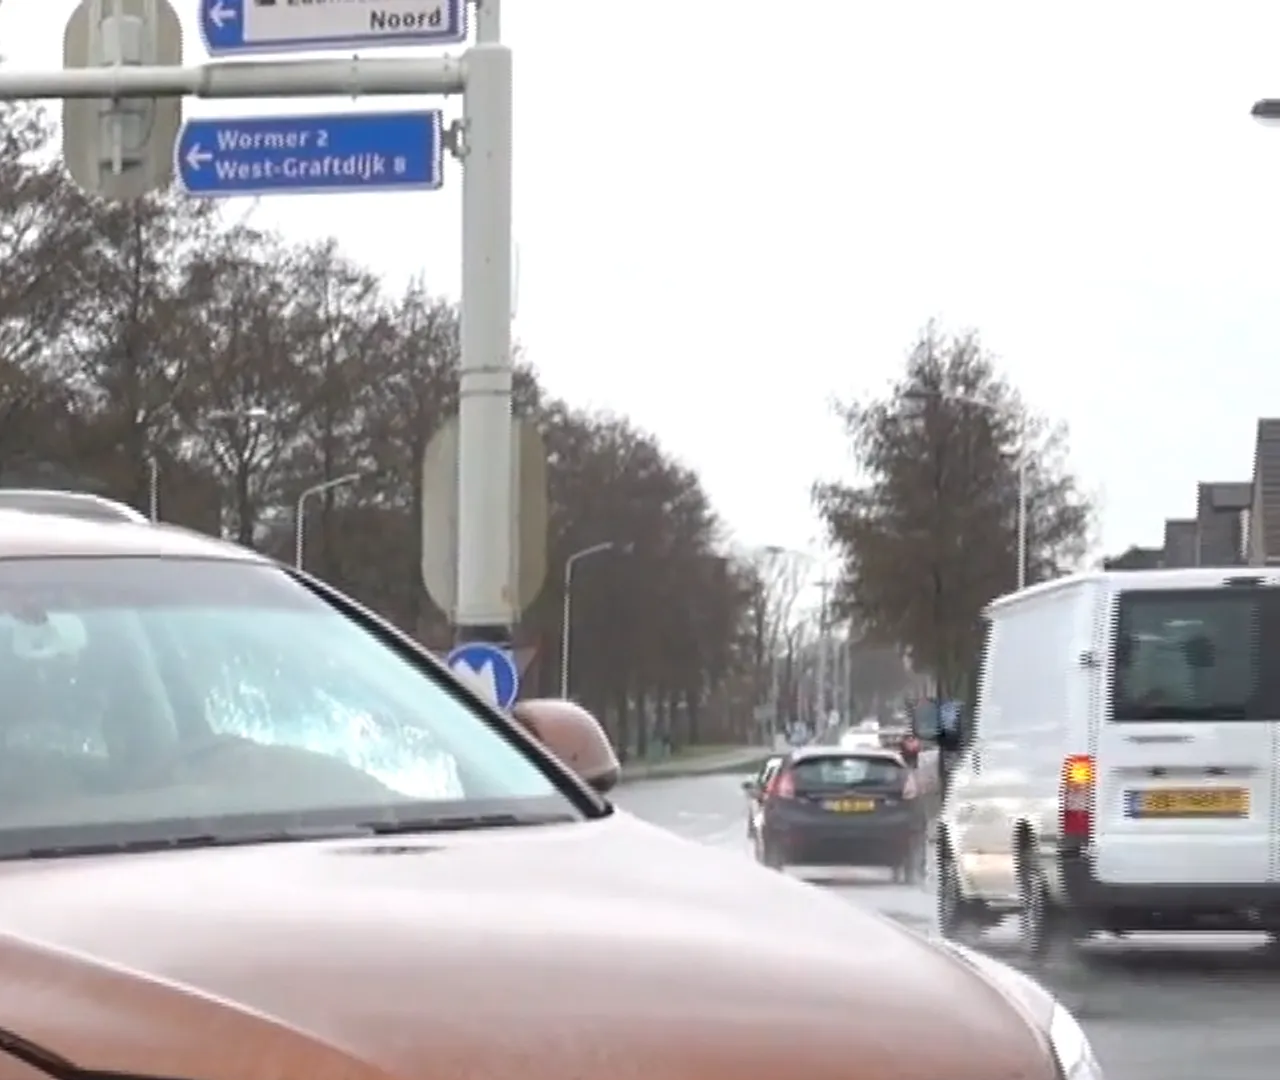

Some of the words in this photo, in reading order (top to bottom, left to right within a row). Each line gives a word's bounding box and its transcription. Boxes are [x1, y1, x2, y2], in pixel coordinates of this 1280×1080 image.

[369, 7, 441, 30] Noord
[216, 129, 310, 151] Wormer
[316, 129, 329, 148] 2
[215, 152, 386, 181] West-Graftdijk
